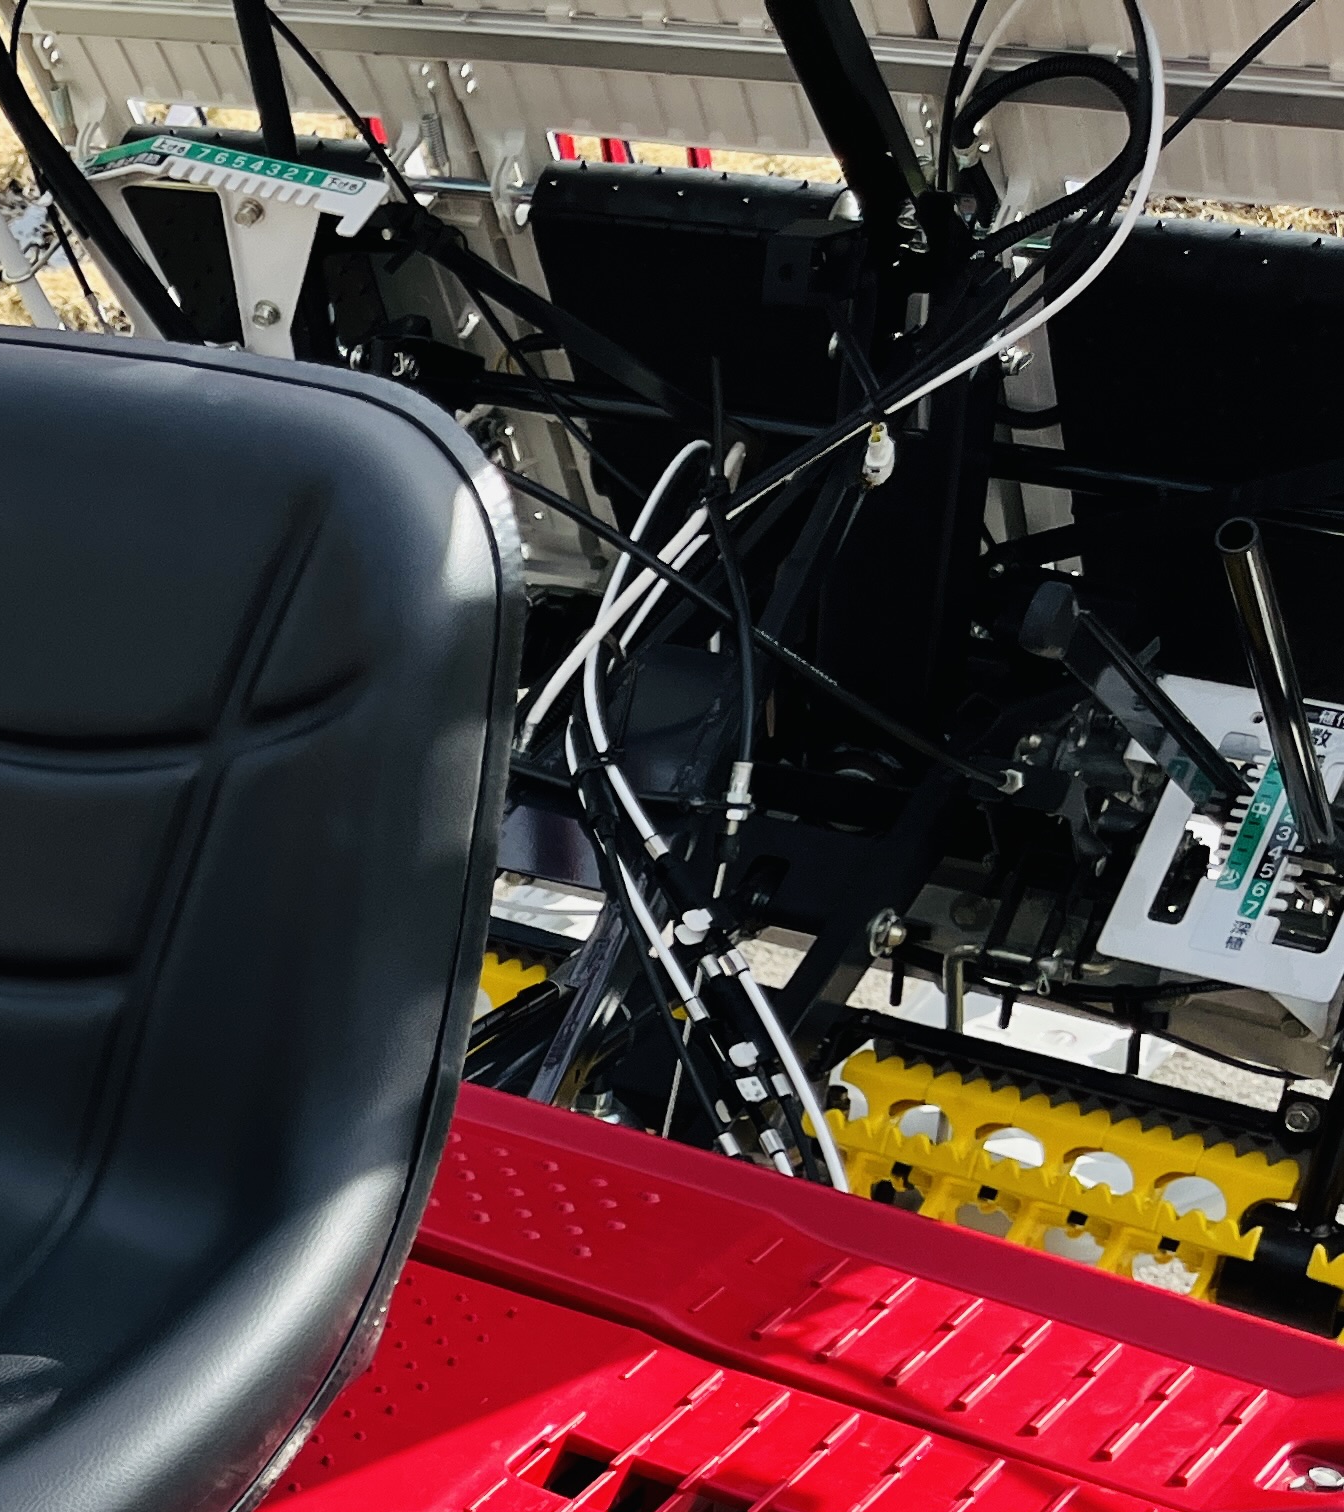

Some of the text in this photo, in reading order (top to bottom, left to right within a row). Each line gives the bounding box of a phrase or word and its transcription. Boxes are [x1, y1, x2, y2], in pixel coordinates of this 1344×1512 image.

[1251, 801, 1271, 818] 中
[1276, 825, 1293, 841] 3
[1268, 845, 1285, 861] 4
[1259, 863, 1276, 879] 5
[1252, 881, 1267, 897] 6
[1244, 901, 1261, 916] 7
